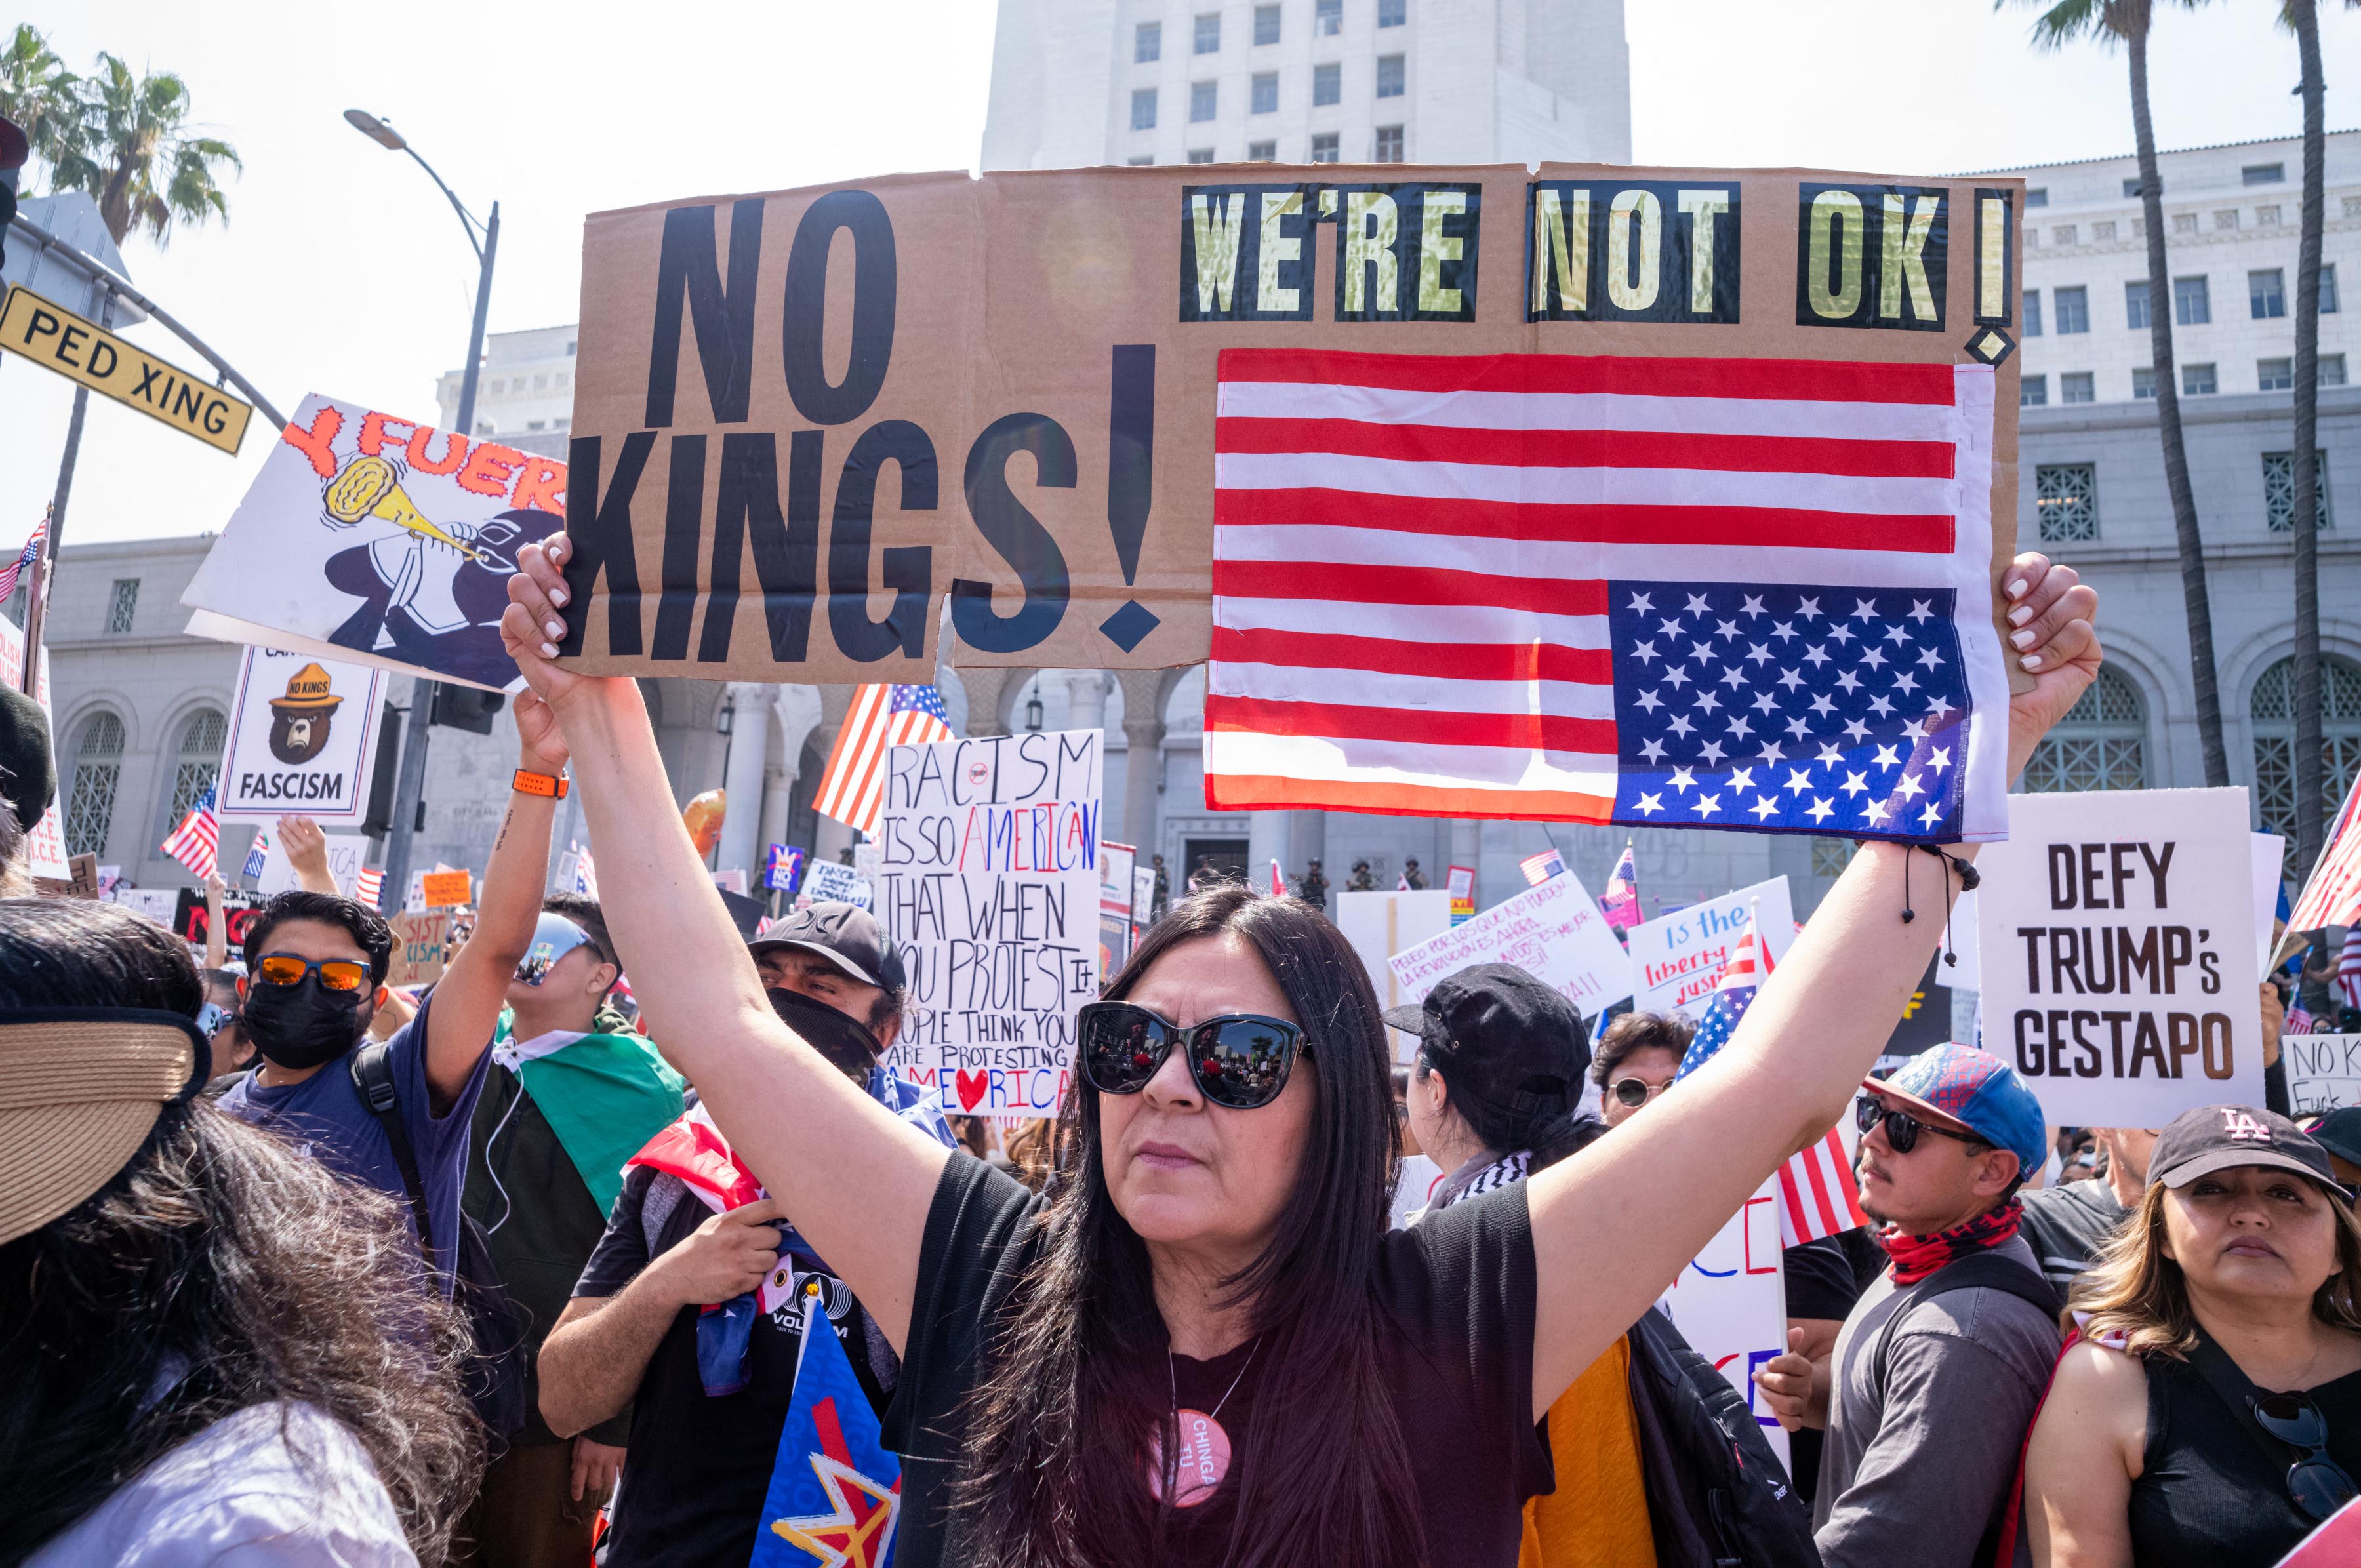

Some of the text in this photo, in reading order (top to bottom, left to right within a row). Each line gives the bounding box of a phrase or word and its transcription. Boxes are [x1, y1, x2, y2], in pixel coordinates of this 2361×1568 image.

[1192, 188, 1467, 313] WE'RE
[1537, 189, 1730, 313] NOT
[645, 190, 897, 428] NO
[24, 308, 230, 435] PED XING
[282, 405, 567, 517] Y FUER
[560, 344, 1161, 663] KINGS!
[289, 681, 327, 694] NO KINGS
[239, 773, 342, 800] FASCISM
[889, 733, 1093, 809] RACISM
[31, 840, 62, 864] I.C.E.
[882, 816, 914, 865] IS
[918, 816, 955, 866] SO
[959, 799, 1099, 872] AMERICAN
[773, 869, 792, 883] NO
[2048, 841, 2176, 910] DEFY
[407, 915, 445, 942] SIST
[881, 873, 954, 941] THAT
[961, 874, 1065, 941] WHEN
[1428, 936, 1455, 953] POR
[1451, 923, 1477, 942] LOS
[1476, 912, 1505, 932] QUE
[1504, 899, 1525, 917] NO
[1697, 906, 1750, 938] the
[1477, 936, 1494, 950] ES
[1645, 946, 1727, 987] liberty
[2017, 925, 2220, 995] TRUMP's
[896, 941, 937, 1003] OU
[948, 939, 1080, 1012] PROTEST
[958, 1011, 1026, 1043] THINK
[1034, 1014, 1078, 1049] YOU
[2013, 1009, 2234, 1080] GESTAPO
[887, 1045, 1068, 1068] ARE PROTESTING
[2293, 1038, 2361, 1076] NO K
[2221, 1108, 2271, 1141] LA
[773, 1312, 848, 1338] VOLM
[1179, 1444, 1194, 1468] TU
[1193, 1420, 1216, 1486] CHINGA
